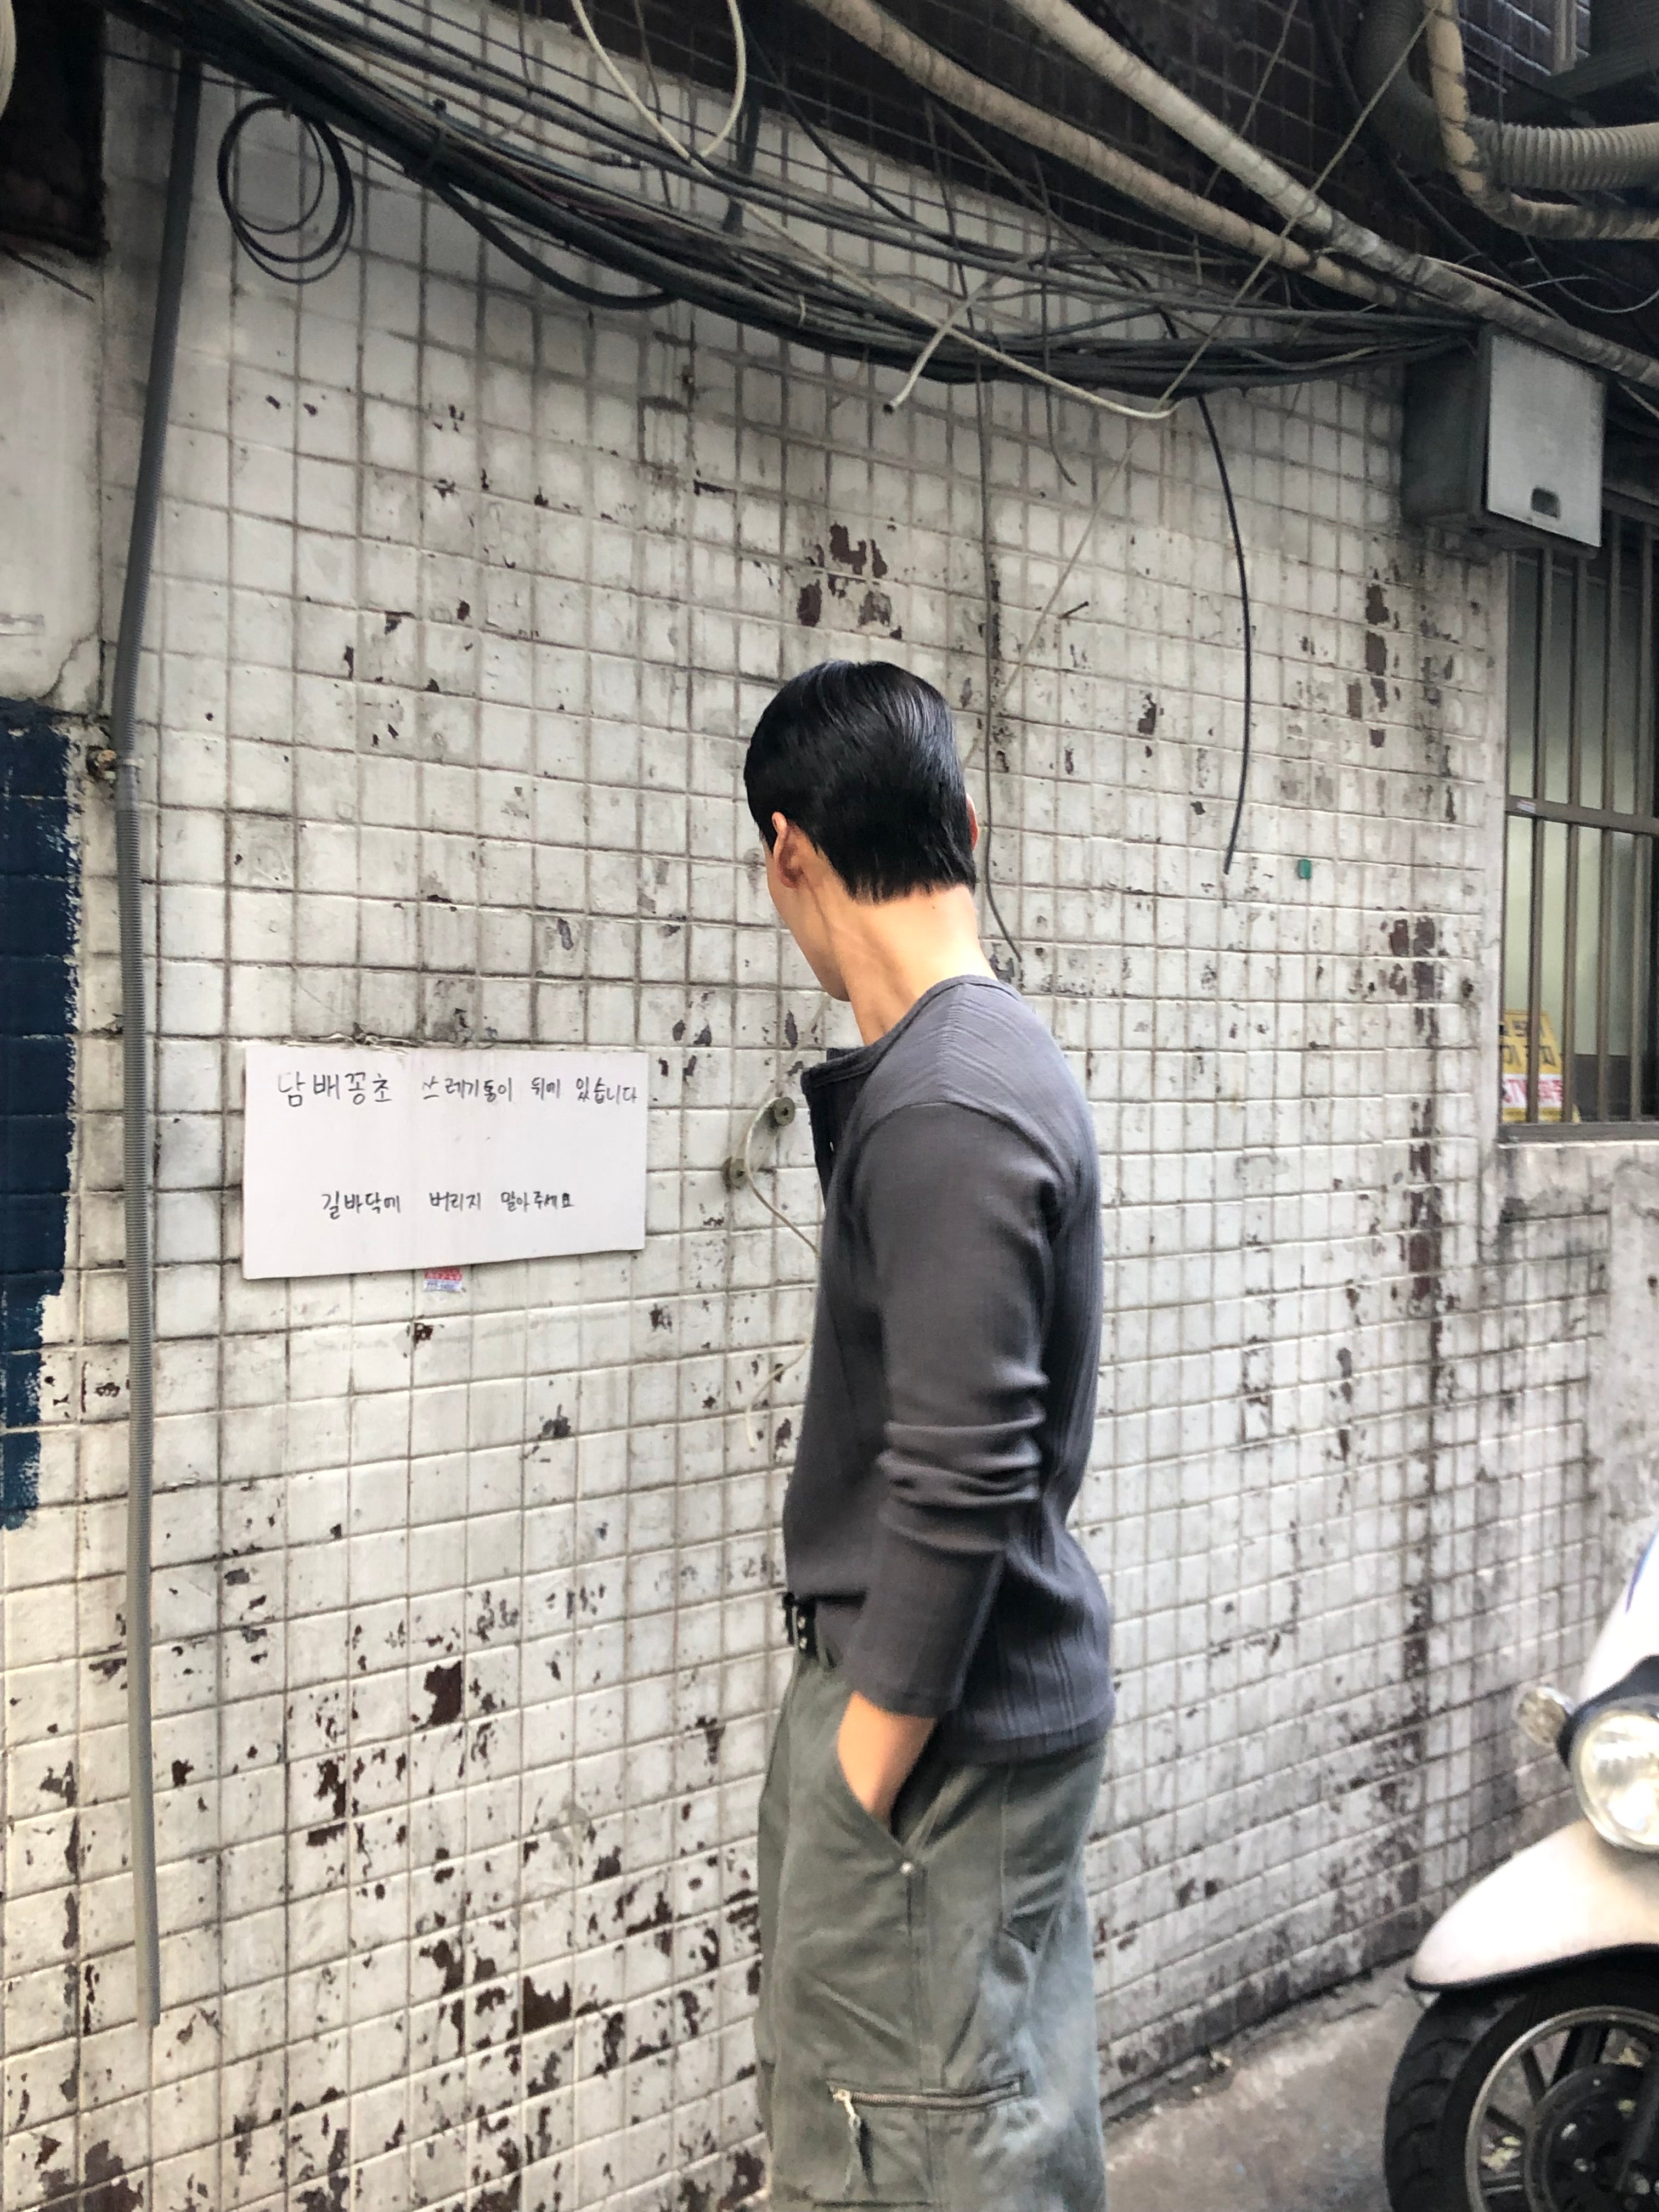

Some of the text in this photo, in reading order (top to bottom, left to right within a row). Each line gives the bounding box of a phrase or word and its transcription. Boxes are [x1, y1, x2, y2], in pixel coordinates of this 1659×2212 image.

[278, 1071, 393, 1108] 담배꽁초
[531, 1076, 561, 1102] 뒤에
[575, 1076, 638, 1105] 있습니다
[320, 1190, 401, 1220] 길바닥에
[428, 1191, 482, 1212] 버리지
